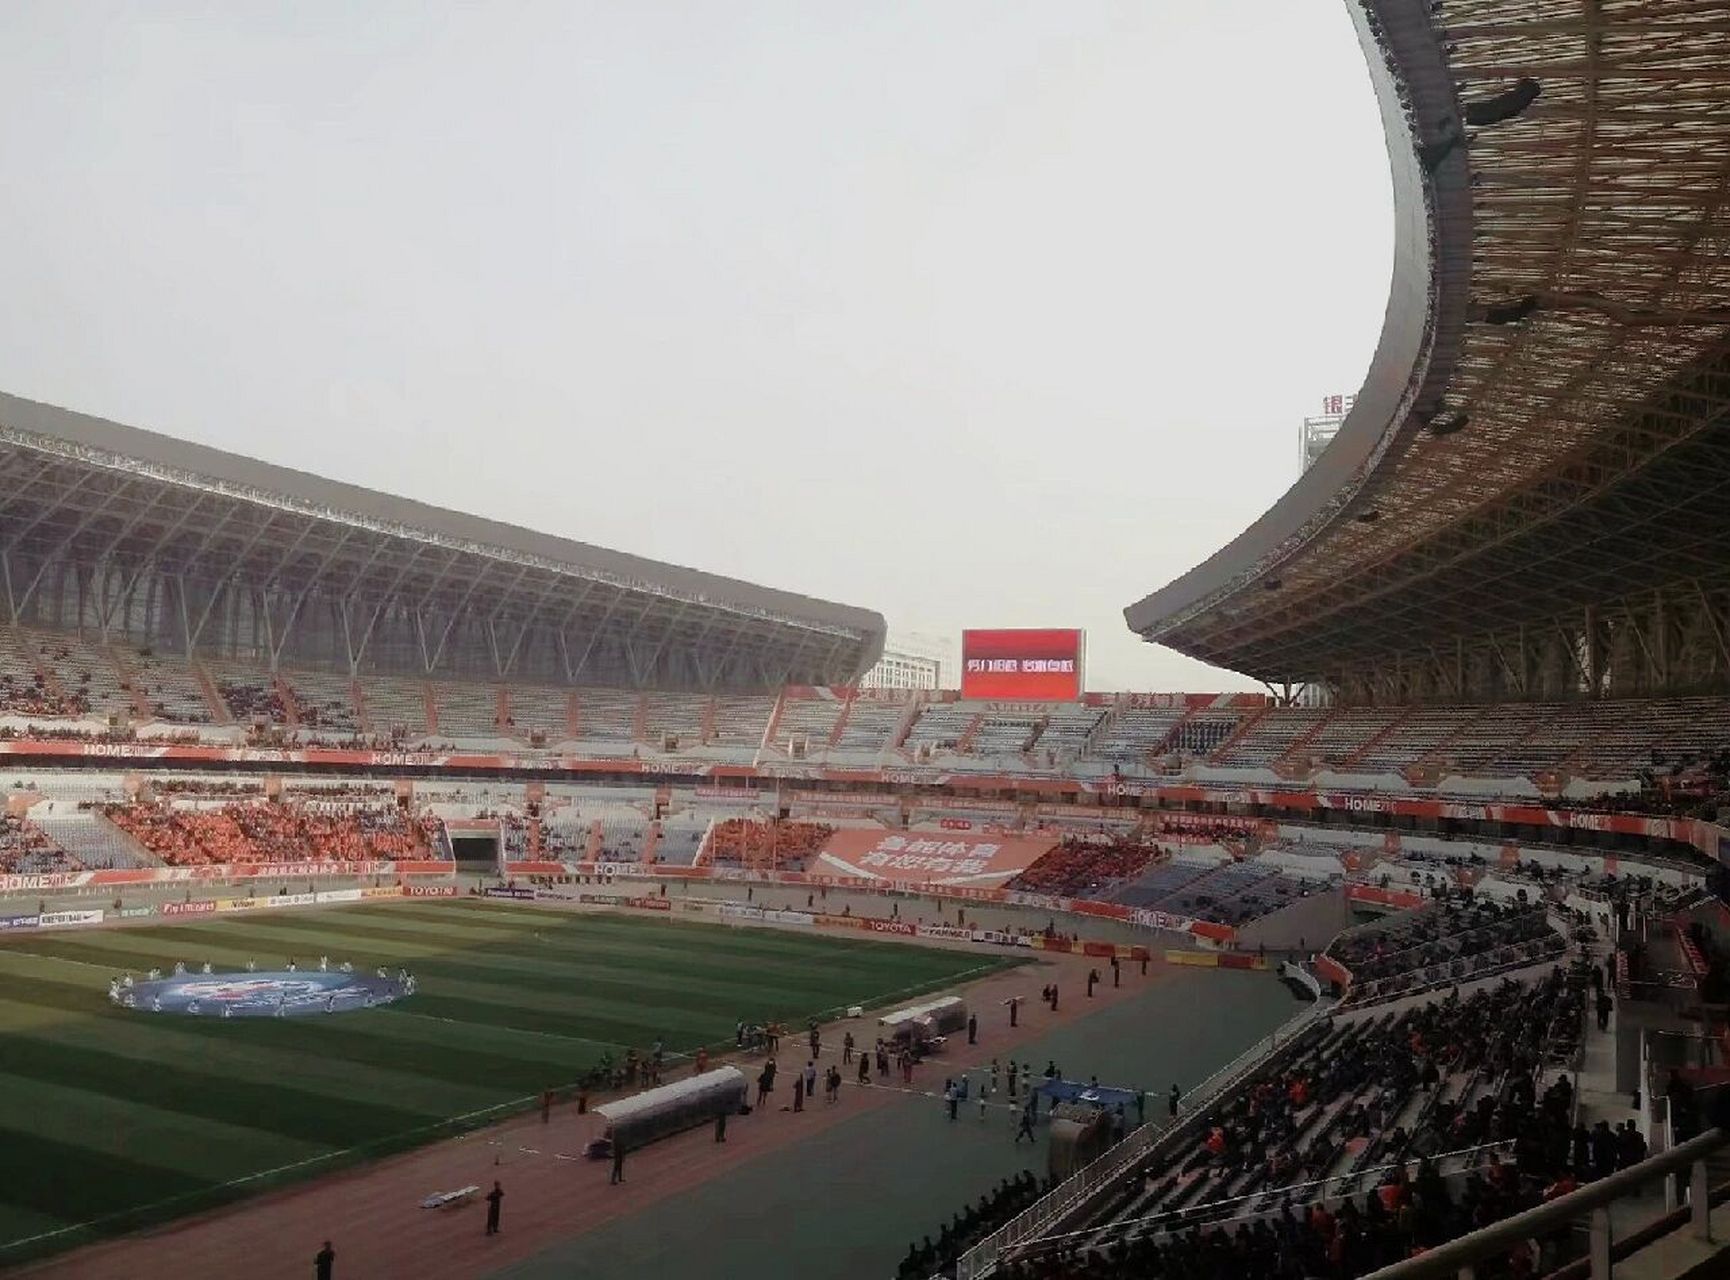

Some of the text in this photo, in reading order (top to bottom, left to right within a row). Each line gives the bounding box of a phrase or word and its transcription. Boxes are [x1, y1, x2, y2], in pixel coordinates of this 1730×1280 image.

[83, 744, 131, 757] HOME
[372, 752, 412, 765] HOME
[641, 763, 681, 774] HOME
[1345, 797, 1382, 812] HOME
[410, 886, 454, 896] TOYOTA
[869, 920, 912, 934] TOYOTA
